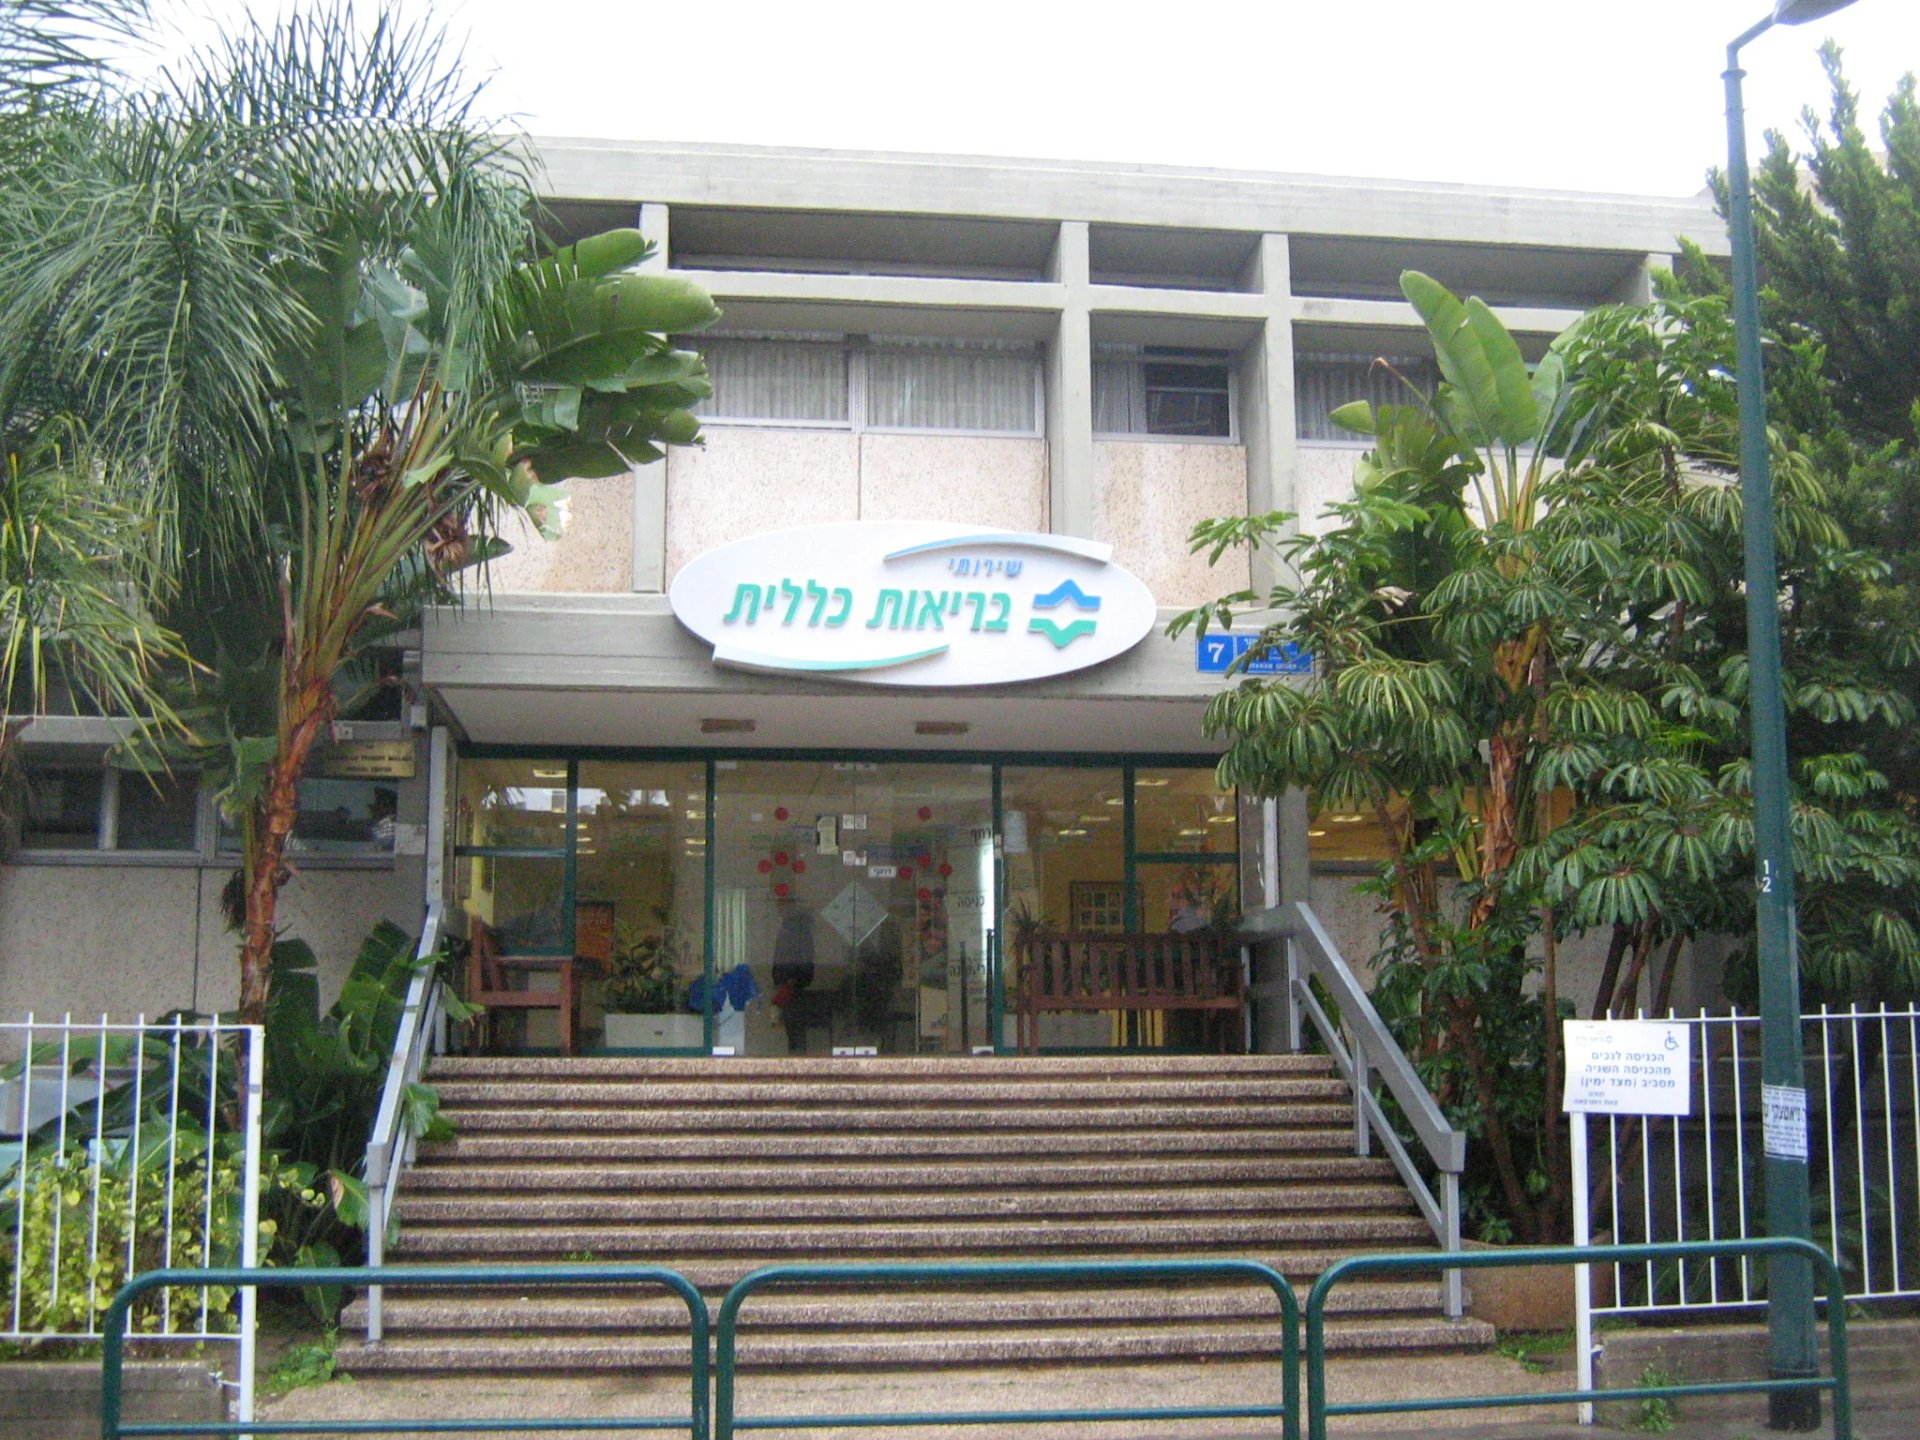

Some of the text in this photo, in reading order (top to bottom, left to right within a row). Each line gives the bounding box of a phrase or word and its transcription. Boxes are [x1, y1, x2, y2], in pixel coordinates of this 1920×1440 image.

[947, 557, 1024, 577] שירותי
[723, 578, 1012, 633] בריאות כללית
[1207, 642, 1225, 664] 7
[1591, 1051, 1665, 1062] הכניסה לנכים
[1585, 1064, 1671, 1076] מהכניסה השניה
[1580, 1077, 1676, 1088] מסביב (מצד ימין)
